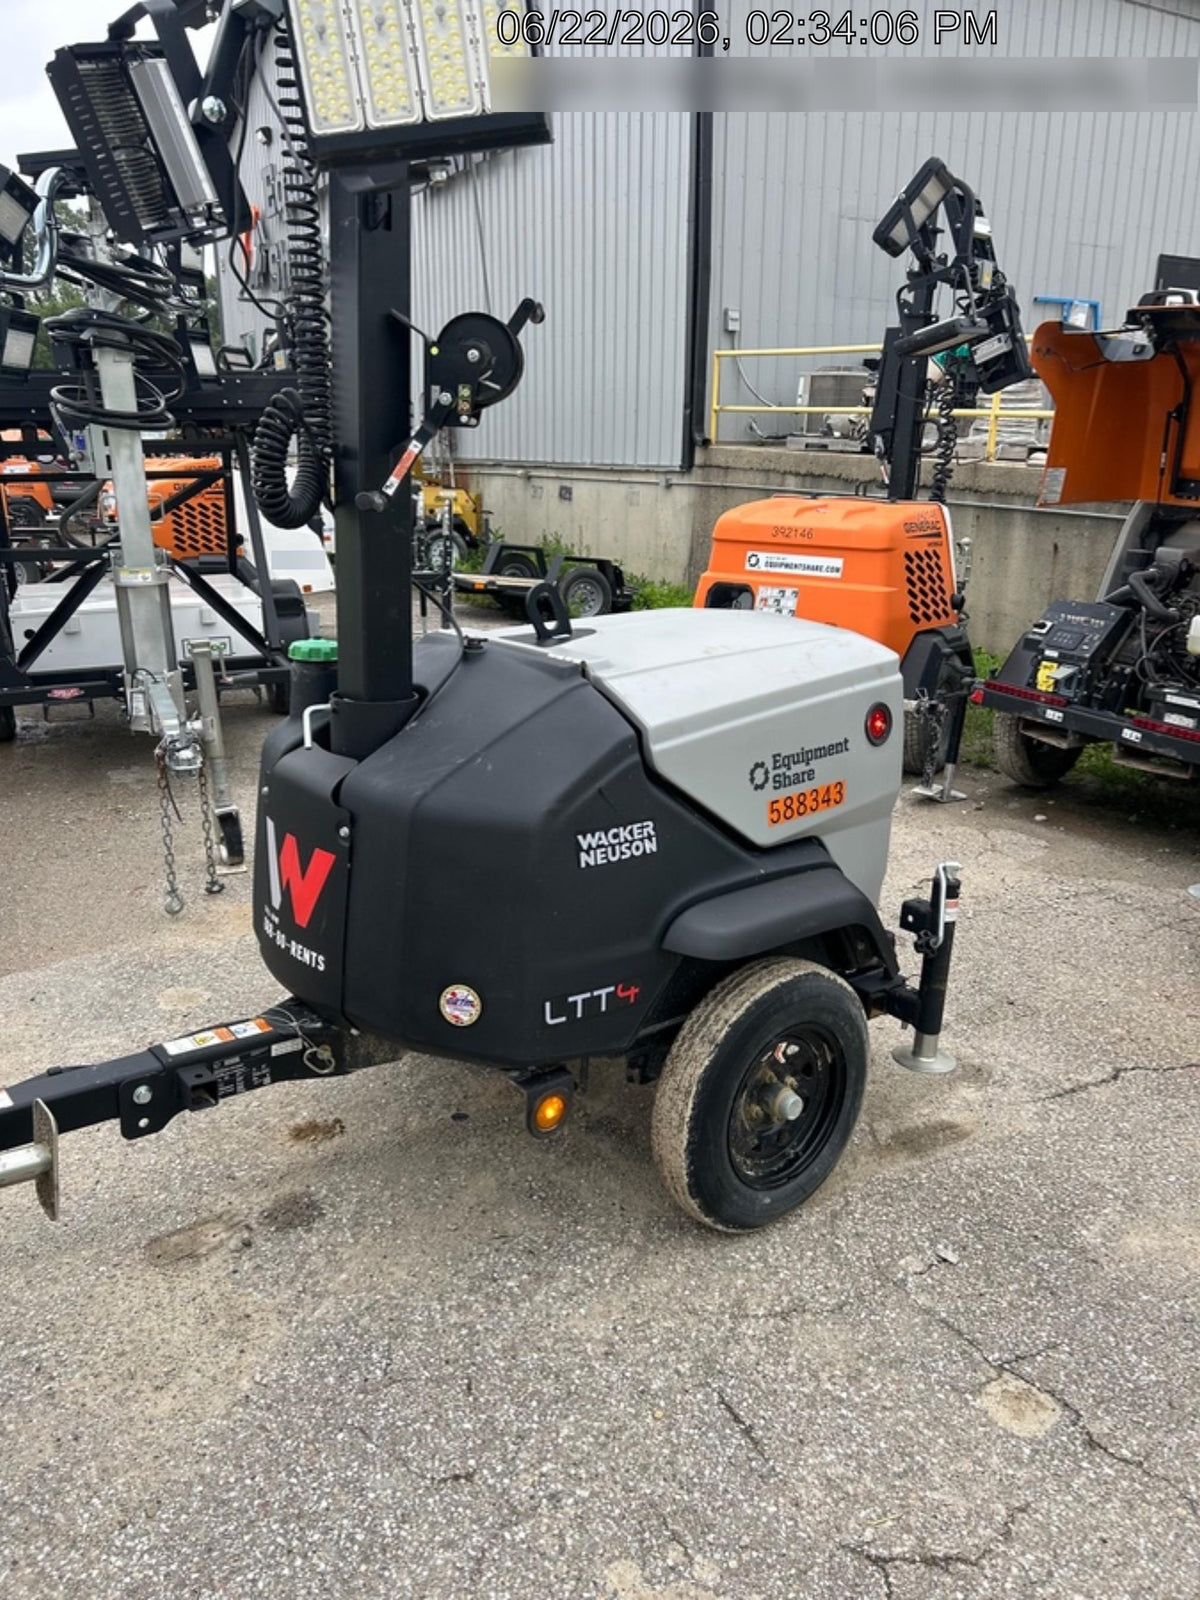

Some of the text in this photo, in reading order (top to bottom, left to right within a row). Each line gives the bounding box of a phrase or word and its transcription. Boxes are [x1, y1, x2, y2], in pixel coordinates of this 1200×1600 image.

[771, 526, 814, 539] 392146
[772, 737, 850, 770] Equipment
[772, 768, 816, 790] Share
[770, 781, 844, 824] 588343
[577, 821, 656, 851] WACKER
[579, 836, 658, 868] NEUSON
[545, 984, 640, 1025] LTT4
